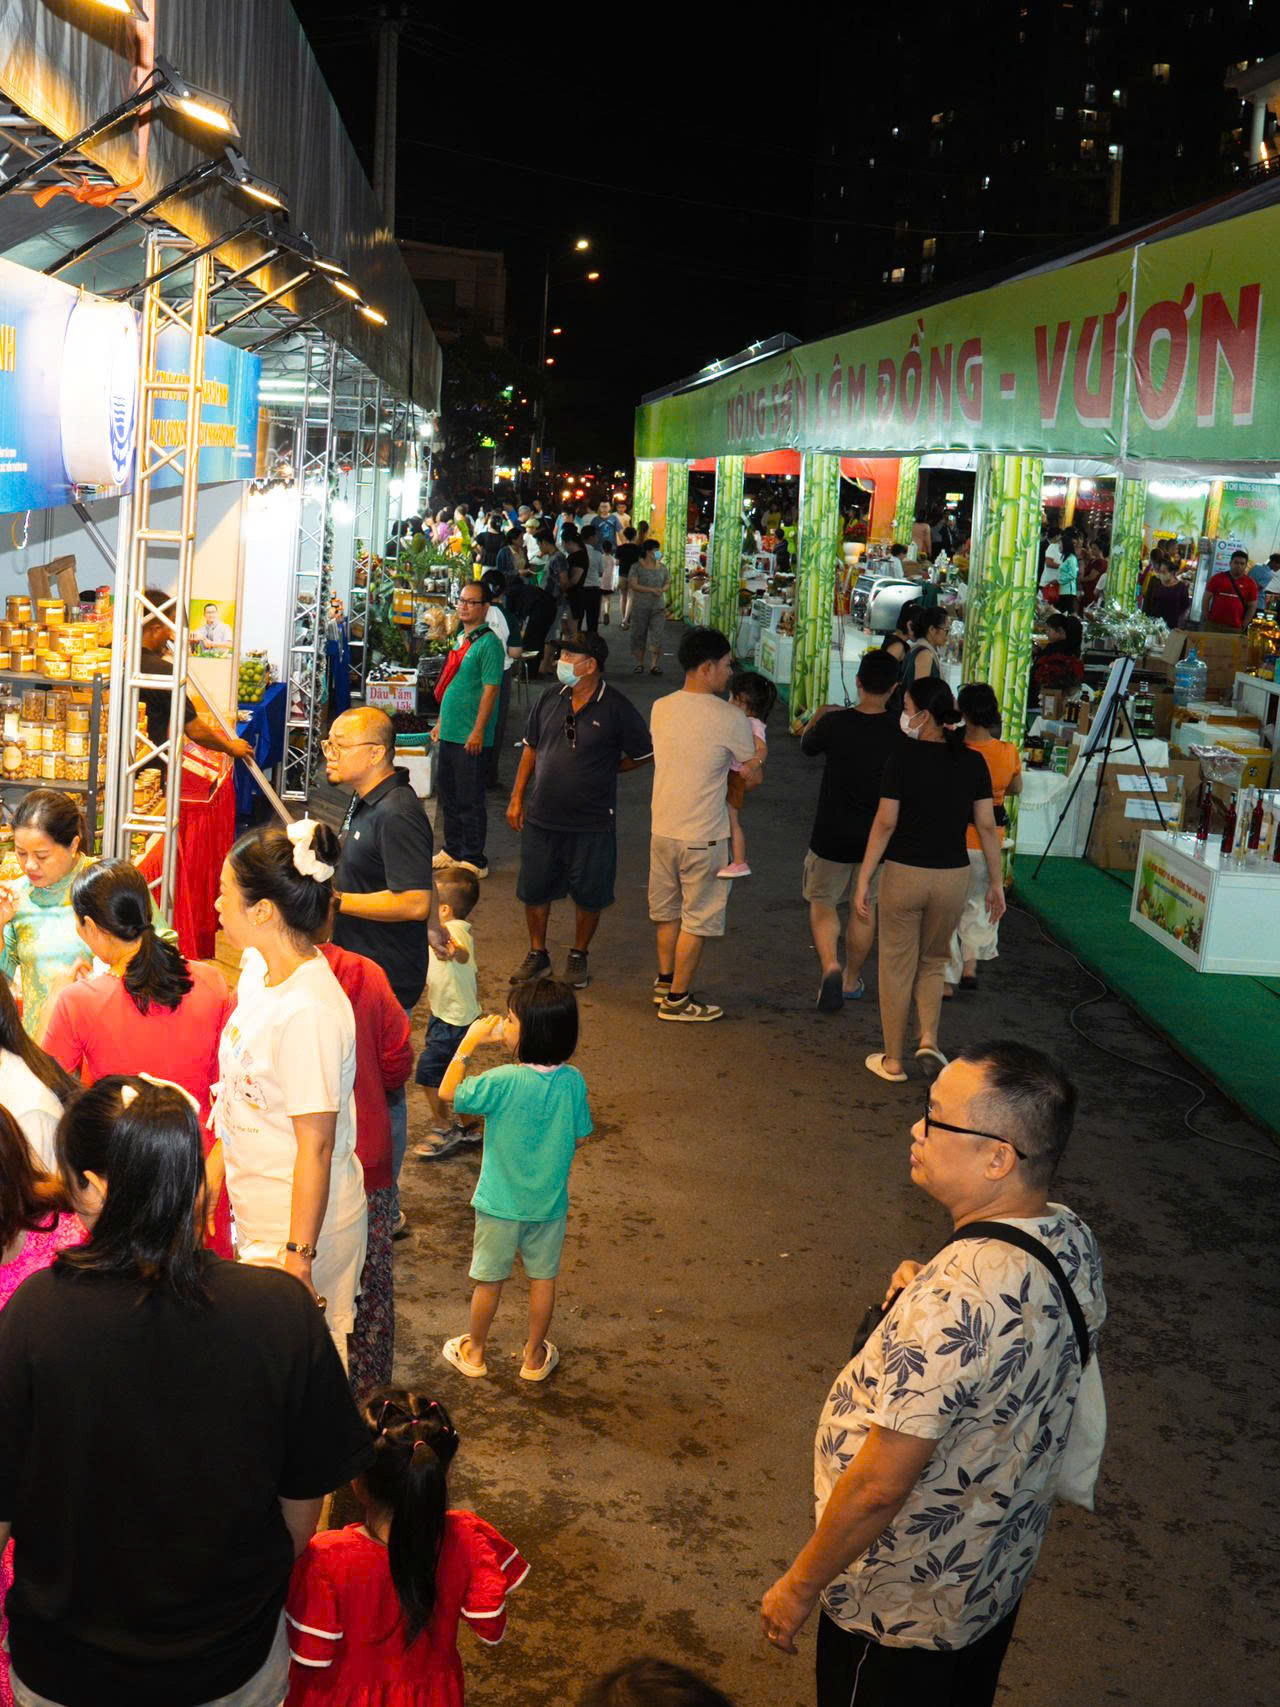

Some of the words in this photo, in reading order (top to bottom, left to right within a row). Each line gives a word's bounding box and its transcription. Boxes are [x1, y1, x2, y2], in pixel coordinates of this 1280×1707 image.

[726, 384, 766, 443] NÔNG
[815, 352, 867, 436] LÂM
[876, 317, 984, 429] ĐỒNG
[1034, 281, 1263, 432] VƯƠN
